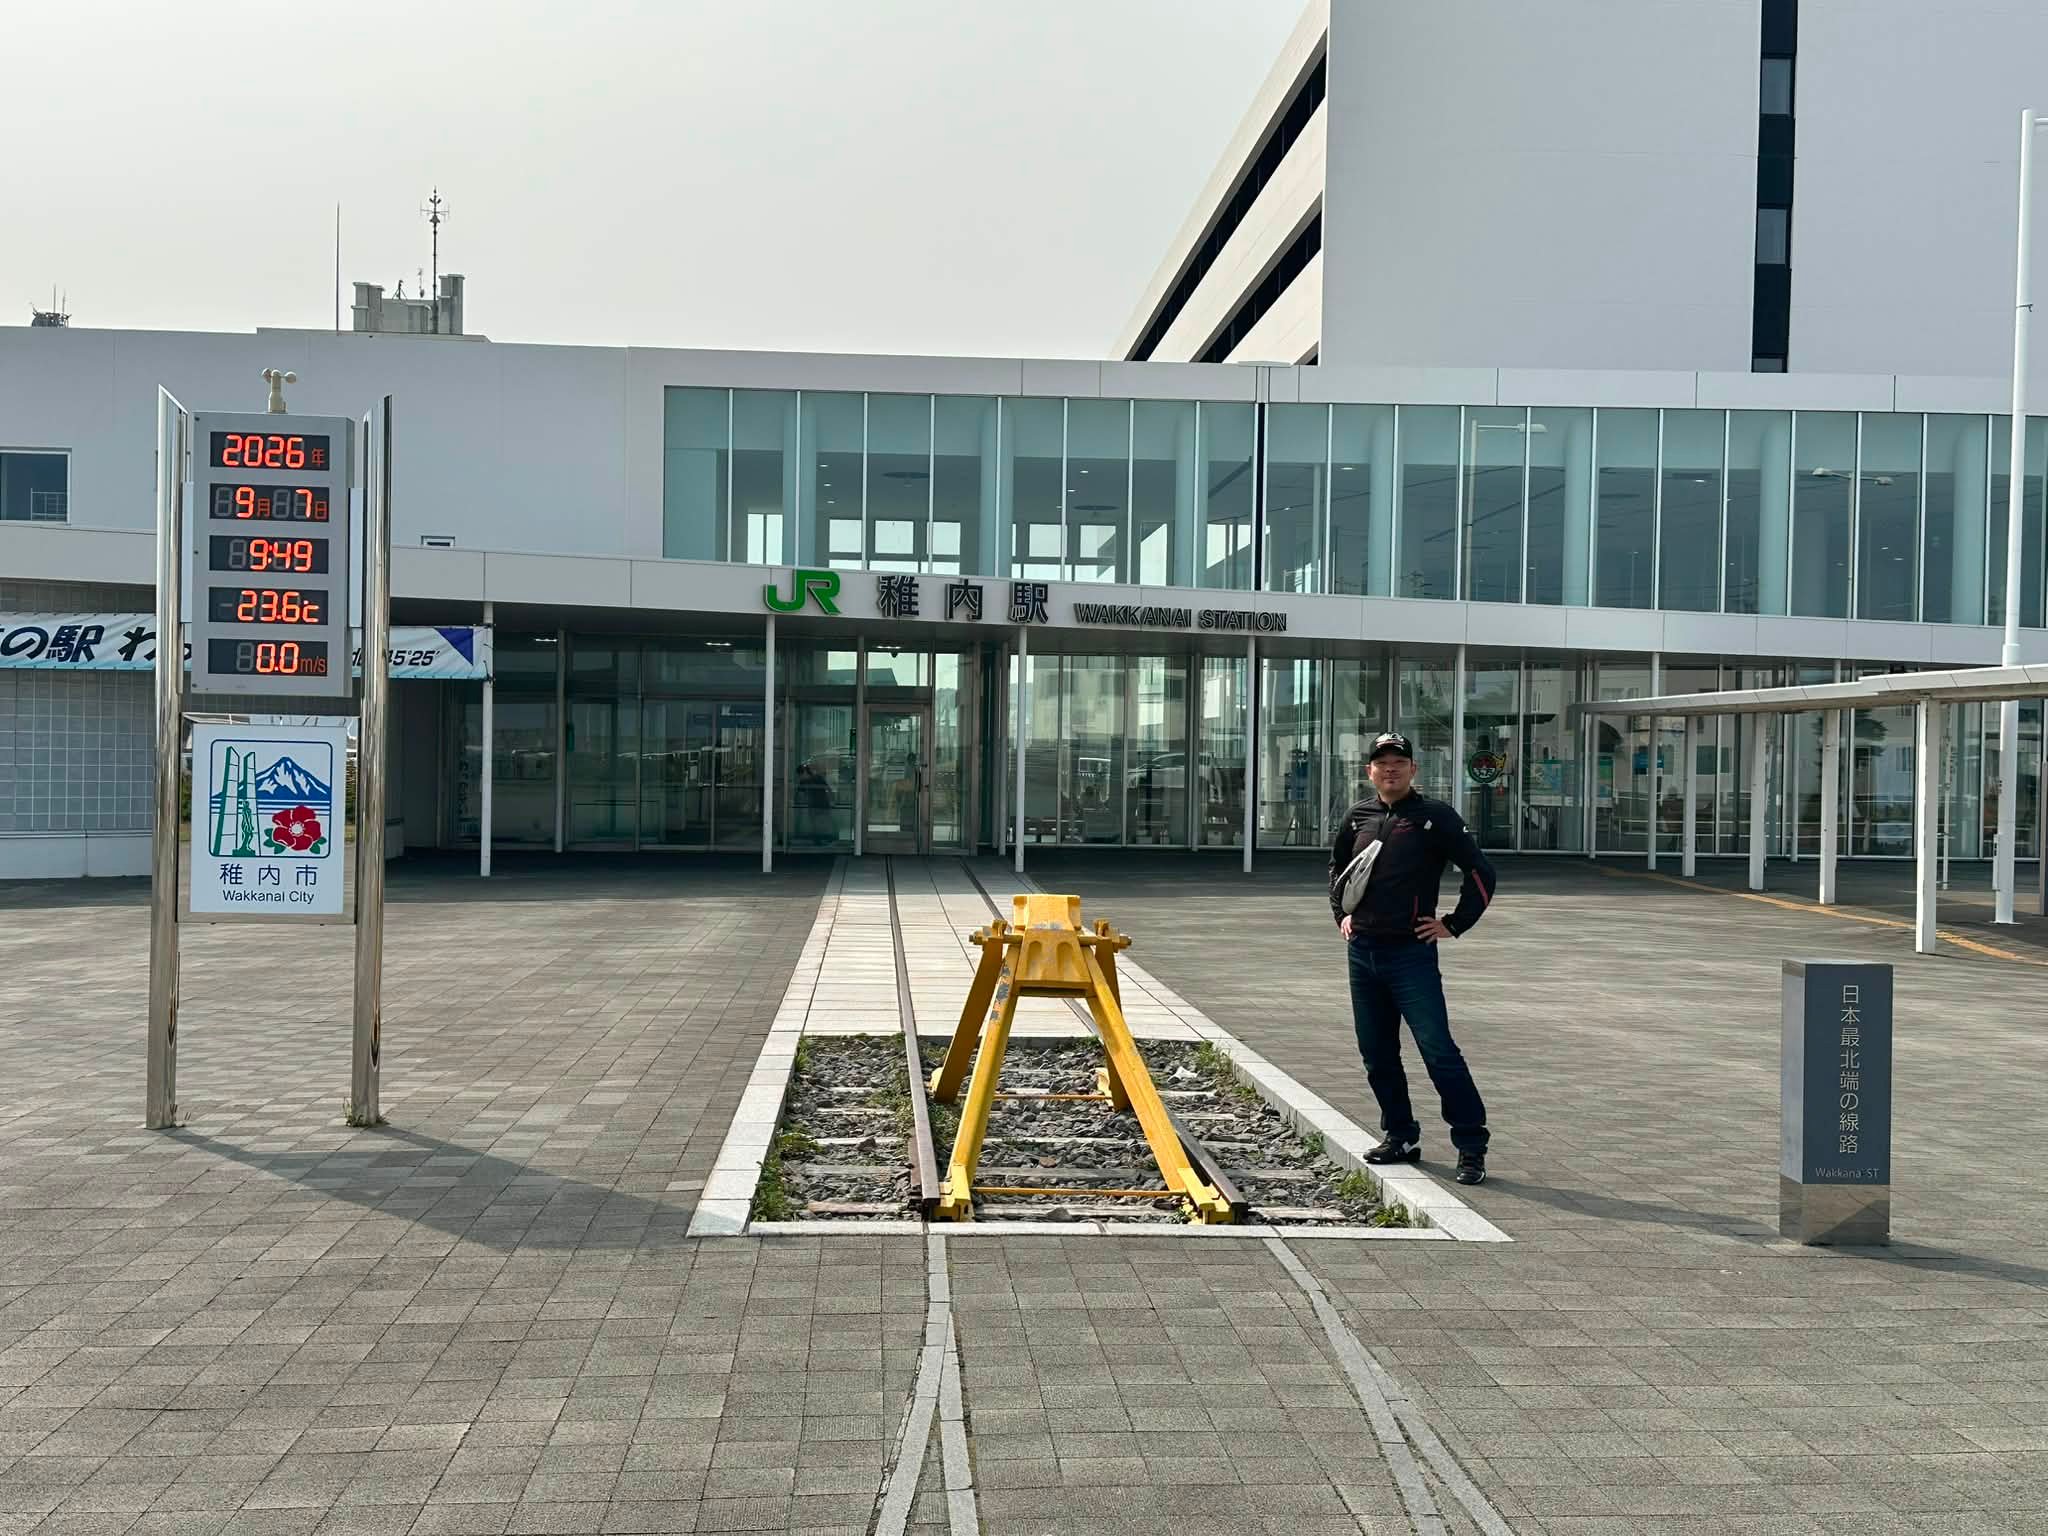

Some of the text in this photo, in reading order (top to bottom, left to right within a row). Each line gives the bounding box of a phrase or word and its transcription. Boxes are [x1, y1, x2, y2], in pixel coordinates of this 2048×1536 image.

[249, 539, 313, 572] 9:49
[763, 569, 842, 616] JR
[876, 575, 1049, 624] 稚内駅
[1073, 603, 1287, 632] WAKKANAI STATION
[0, 624, 105, 663] の駅
[219, 863, 318, 887] 稚内市
[222, 889, 315, 905] Wakkanai City
[1839, 984, 1861, 1154] 日本最北端の線路
